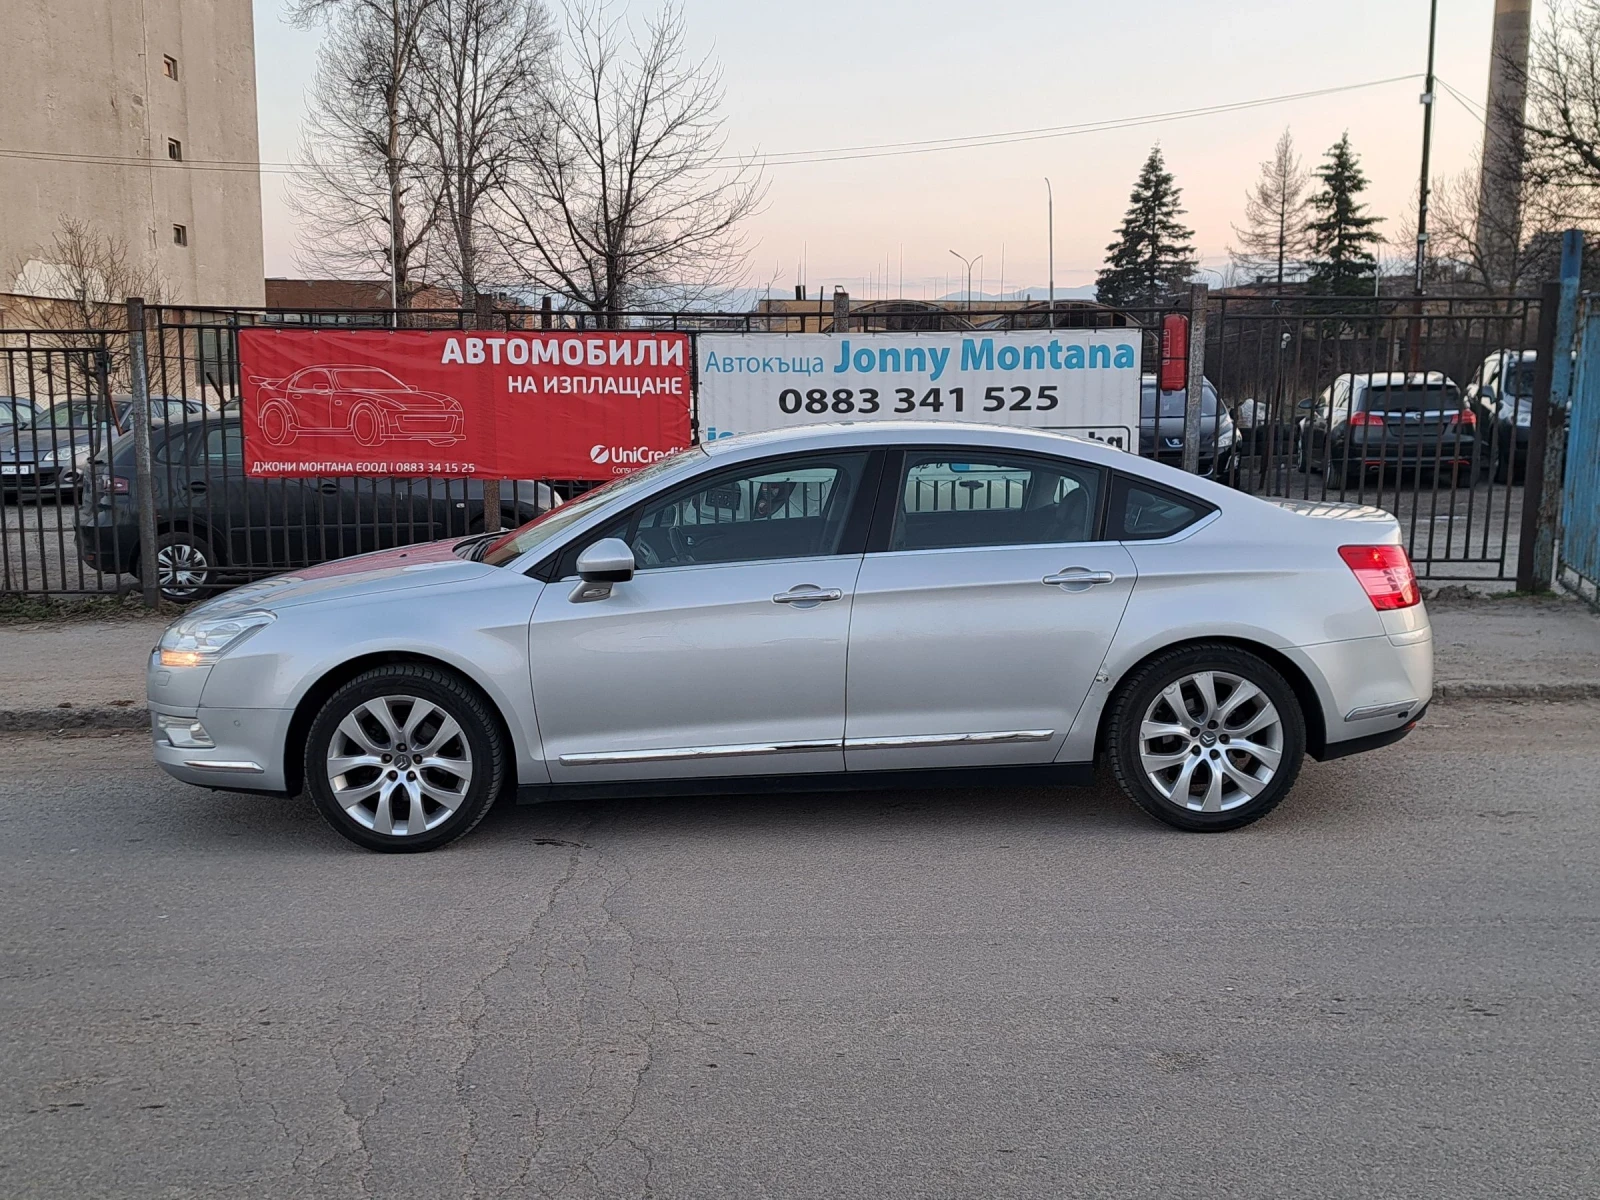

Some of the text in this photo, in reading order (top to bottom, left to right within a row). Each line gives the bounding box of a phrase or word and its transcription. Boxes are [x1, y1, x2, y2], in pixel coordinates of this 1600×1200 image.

[441, 337, 684, 366] АВТОМОБИЛИ
[705, 351, 824, 377] Автокъща
[833, 340, 950, 381] Jonny
[960, 338, 1135, 371] Montana
[507, 375, 683, 398] НА ИЗПЛАЩАНЕ
[778, 385, 1059, 414] 0883 341 525
[252, 461, 297, 473] ДЖОНИ
[299, 462, 353, 473] МОНТАНА
[356, 462, 388, 473] ЕООД
[396, 462, 424, 473] 0883
[427, 463, 441, 473] 34
[444, 463, 459, 473] 15
[461, 463, 475, 473] 25
